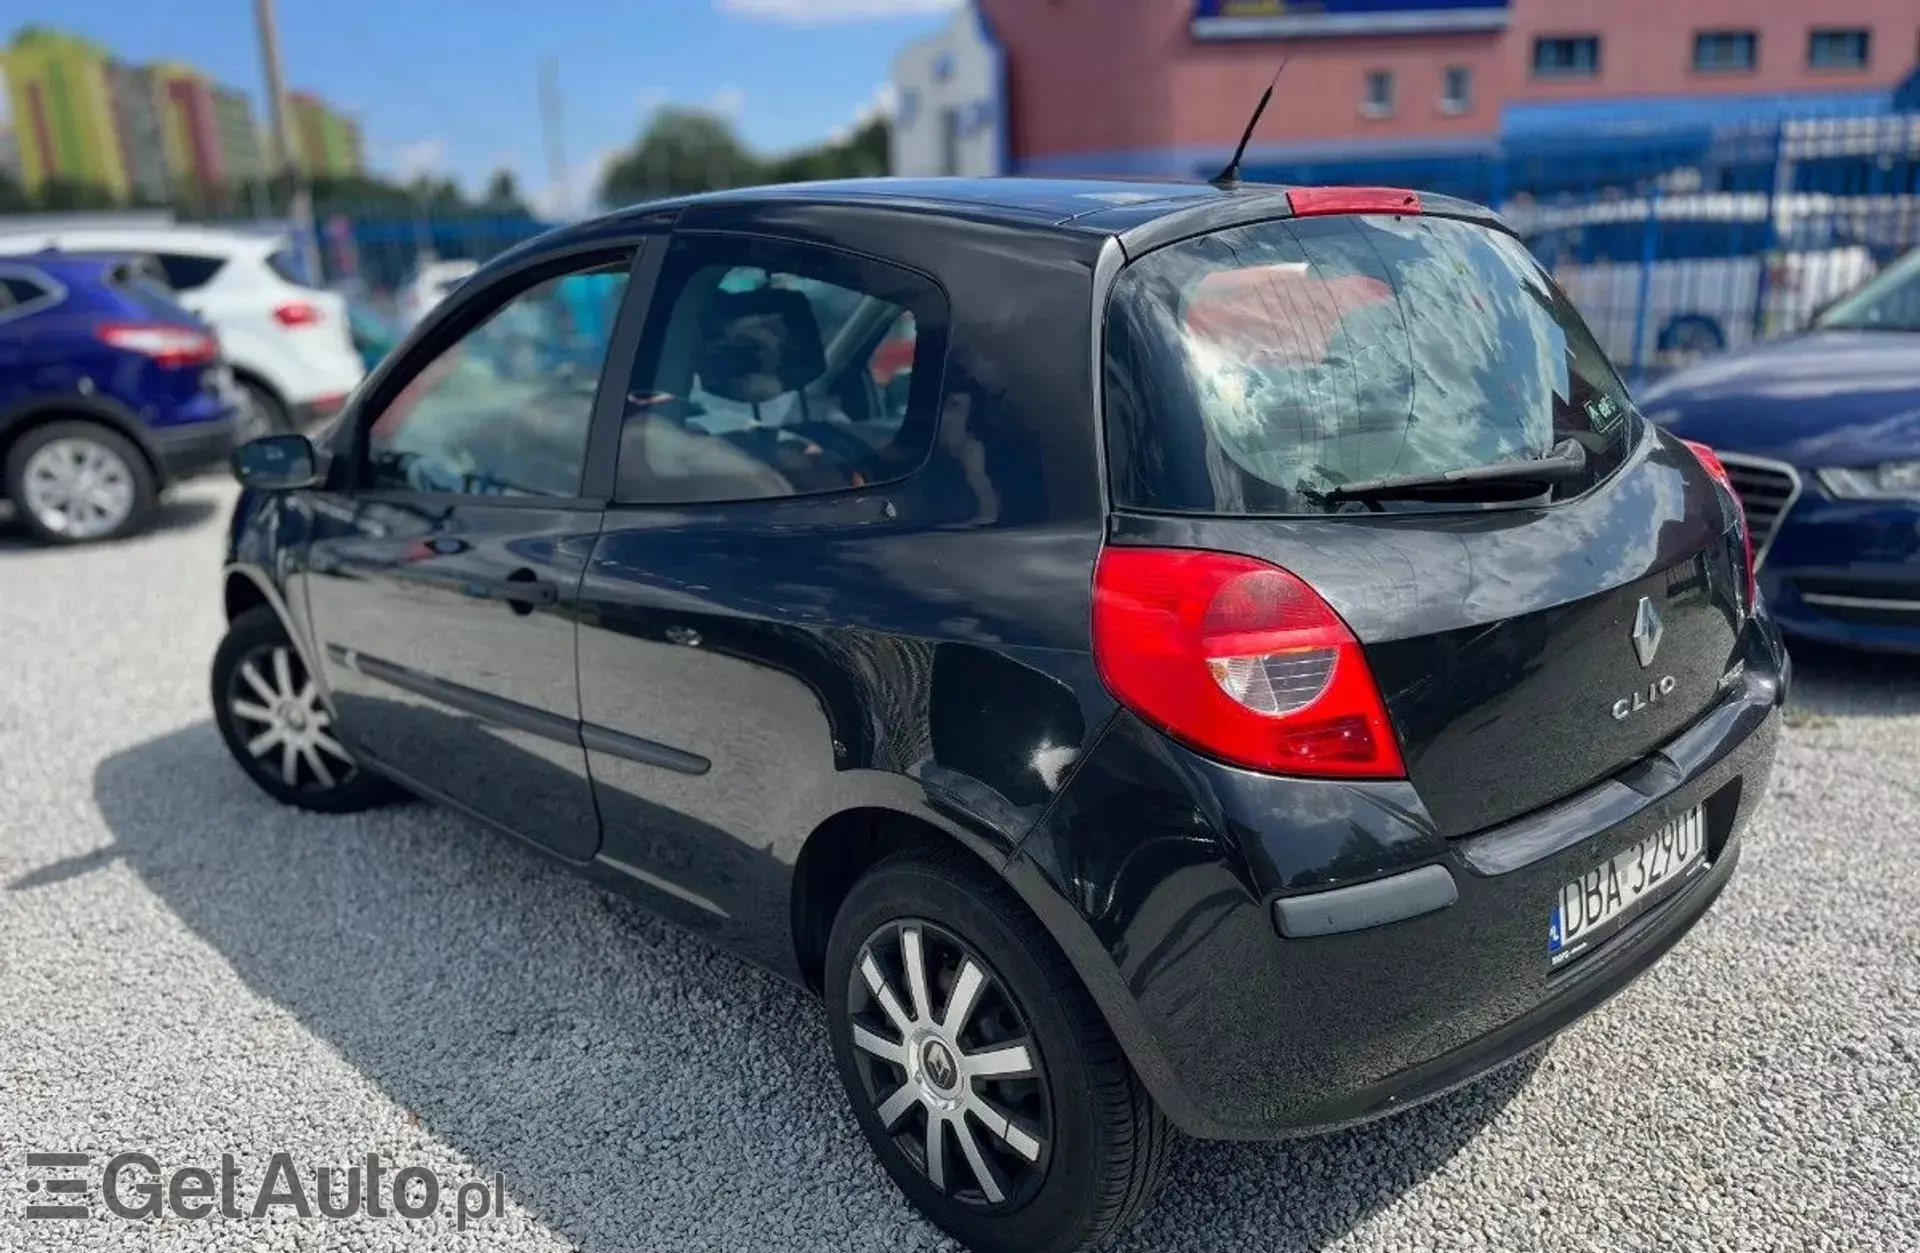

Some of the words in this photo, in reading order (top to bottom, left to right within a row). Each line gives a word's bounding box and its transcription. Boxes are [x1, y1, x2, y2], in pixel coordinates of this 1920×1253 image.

[1611, 675, 1675, 720] CLIO
[1563, 858, 1622, 940] DBA
[1630, 806, 1699, 894] 32901
